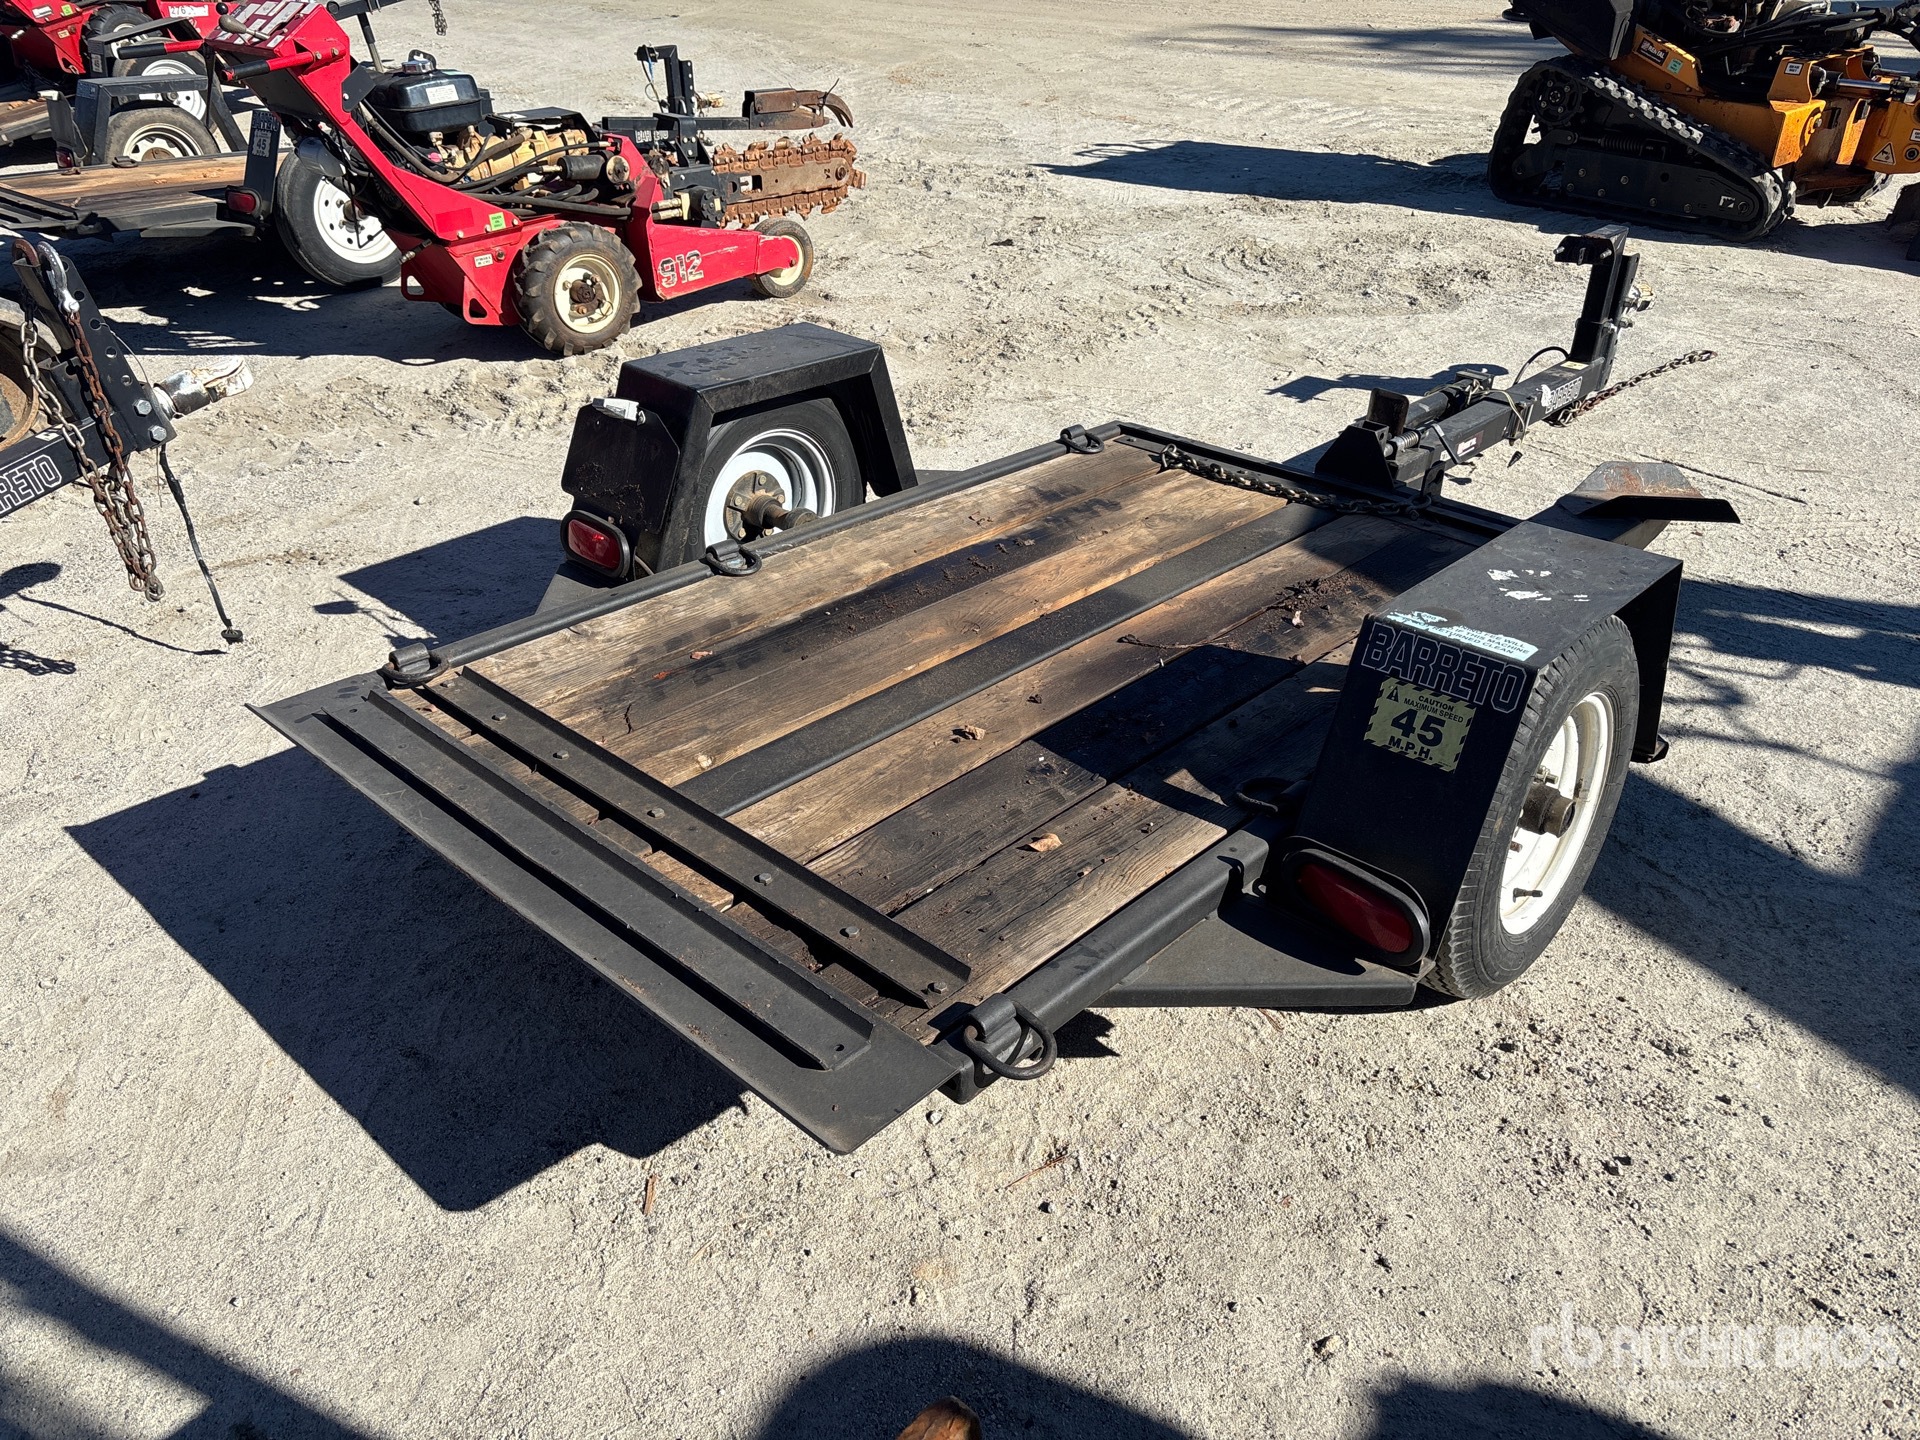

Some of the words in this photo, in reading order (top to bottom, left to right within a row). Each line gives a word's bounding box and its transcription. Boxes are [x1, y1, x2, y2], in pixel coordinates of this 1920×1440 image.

[256, 138, 267, 150] 45
[658, 250, 704, 288] 912
[0, 454, 63, 514] RETO
[1432, 626, 1481, 644] RETURNED
[1482, 641, 1514, 654] CLEAN
[1466, 631, 1486, 641] THIS
[1487, 638, 1530, 654] MACHINE
[1484, 633, 1502, 641] FEE
[1504, 638, 1526, 649] WILL
[1361, 621, 1527, 714] BARRETO
[1403, 697, 1439, 715] MAXIMUM
[1439, 709, 1464, 724] SPEED
[1418, 695, 1455, 712] CAUTION
[1390, 708, 1447, 748] 45
[1388, 735, 1434, 761] M.P.H.
